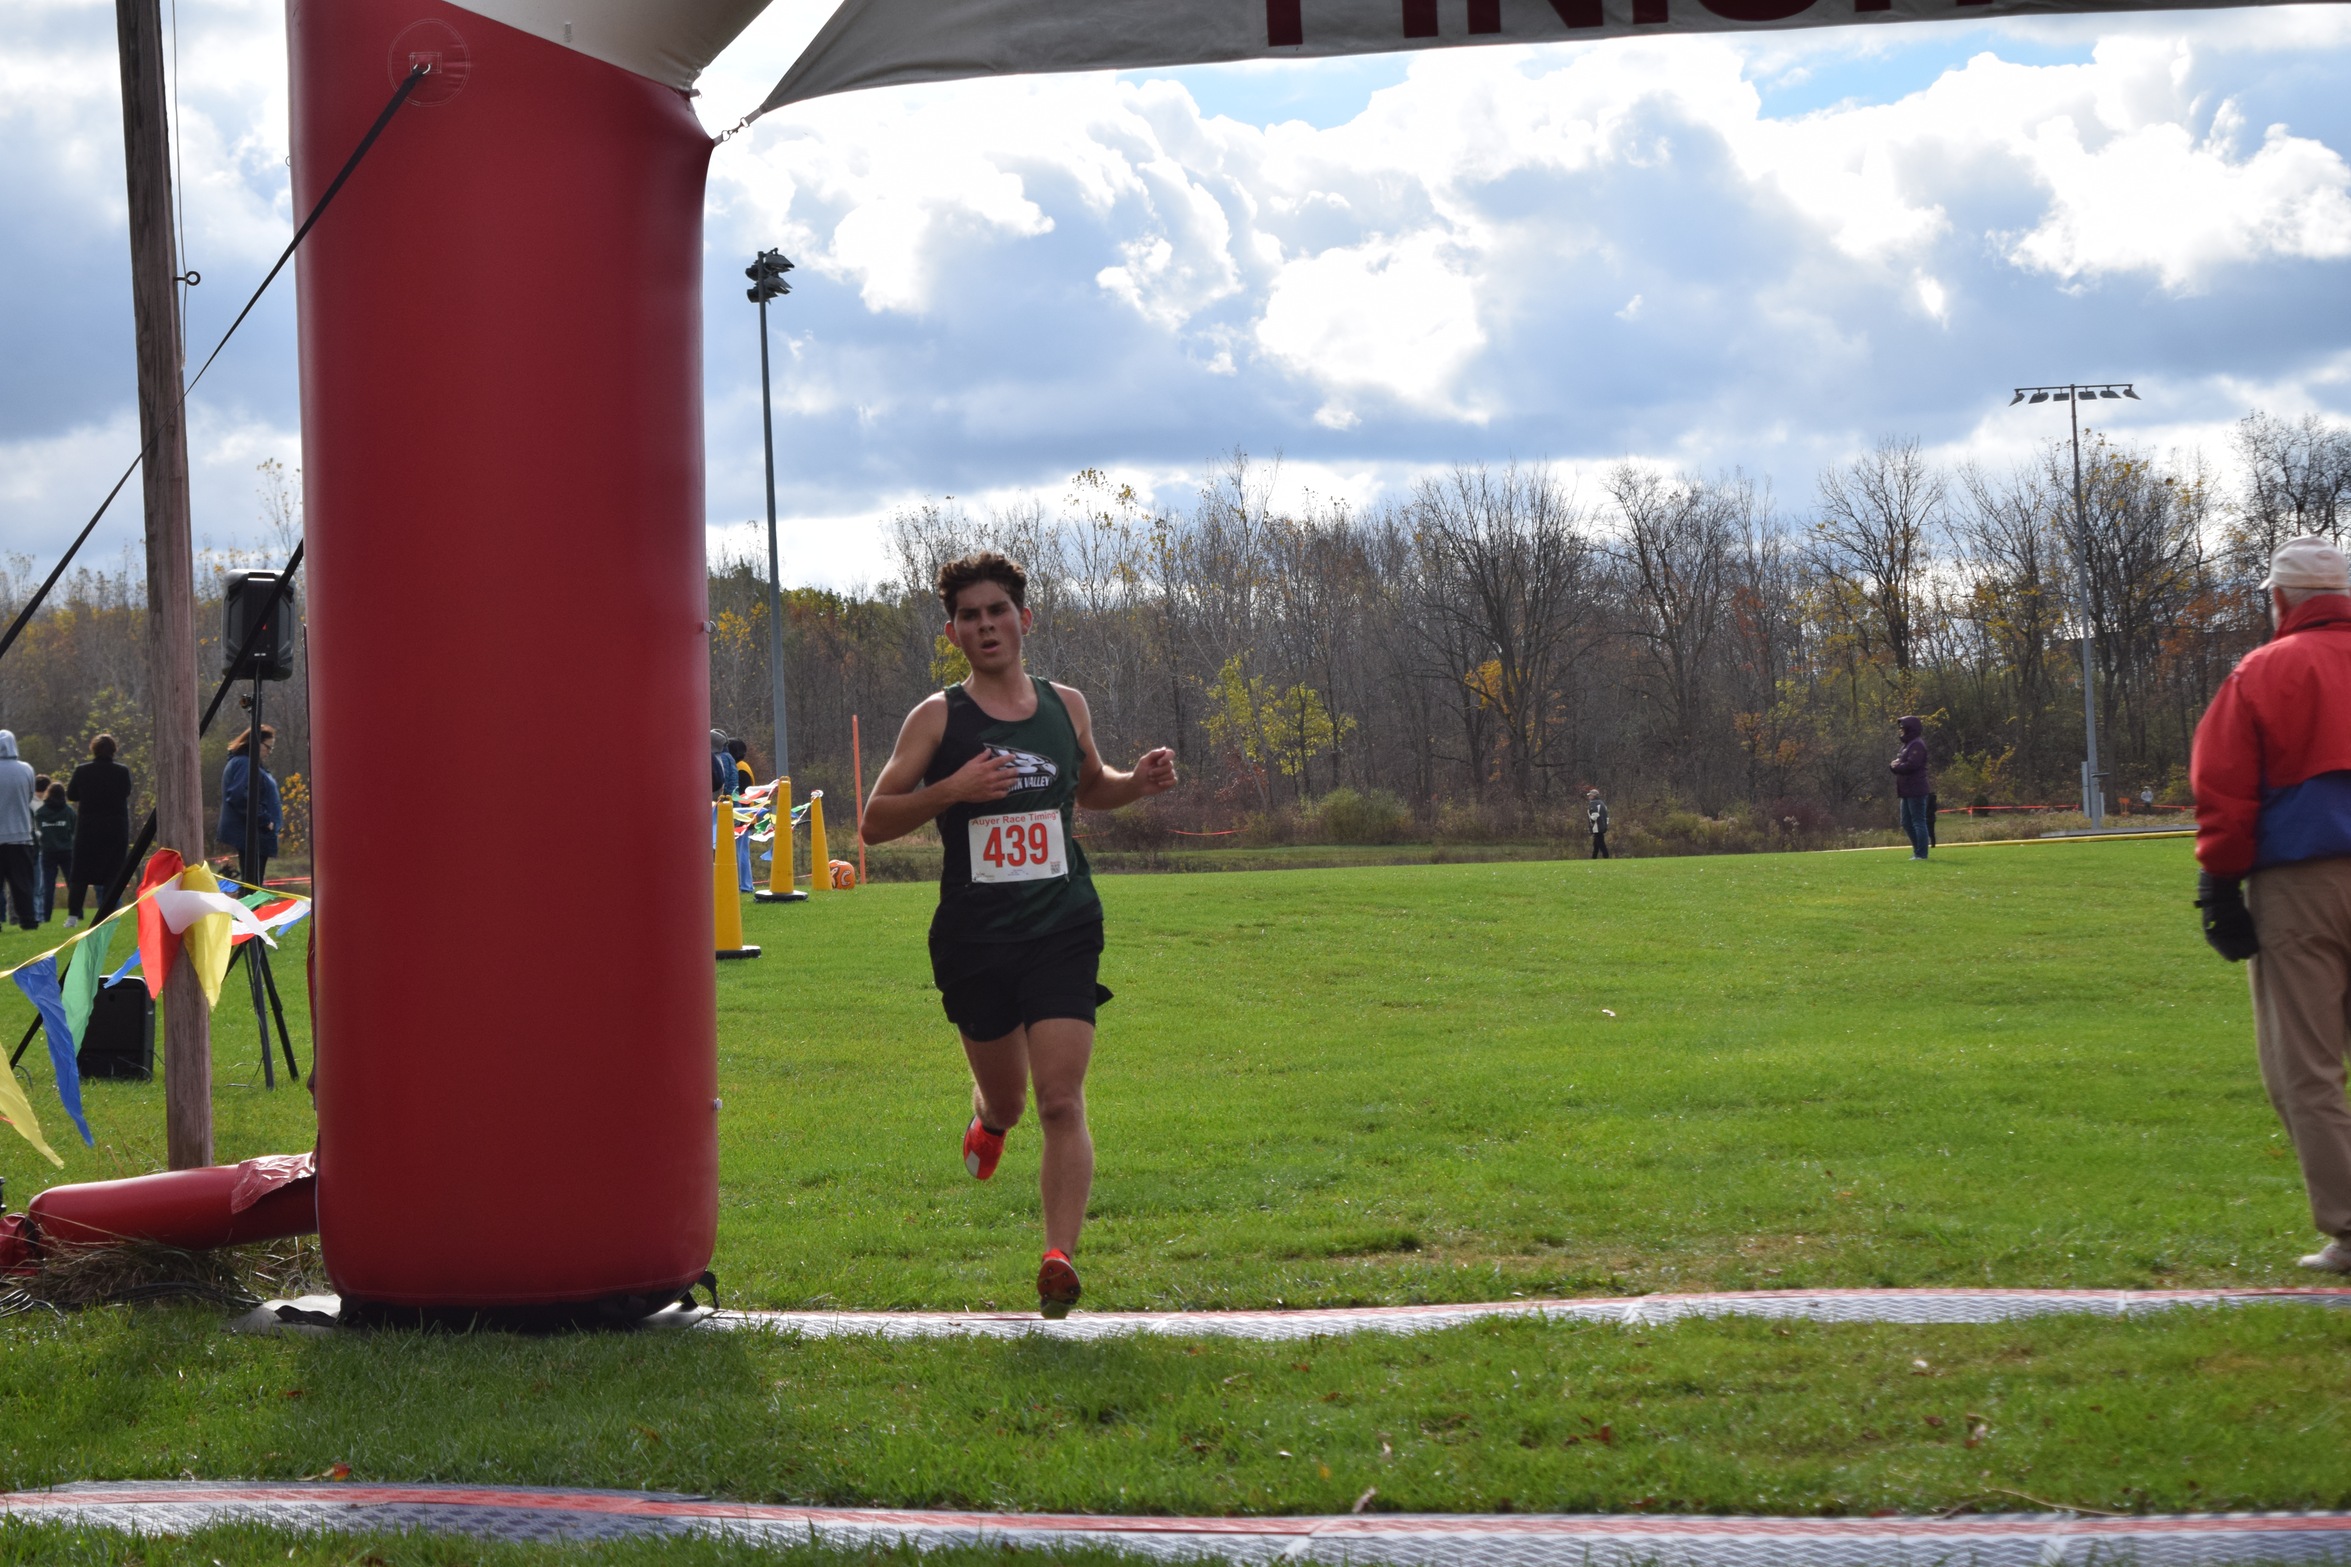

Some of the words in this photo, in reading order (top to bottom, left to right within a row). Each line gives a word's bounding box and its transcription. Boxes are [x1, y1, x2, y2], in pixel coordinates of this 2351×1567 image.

[1024, 776, 1050, 788] VALLEY
[1003, 815, 1026, 824] Race
[1028, 811, 1057, 821] Timing
[983, 822, 1049, 868] 439
